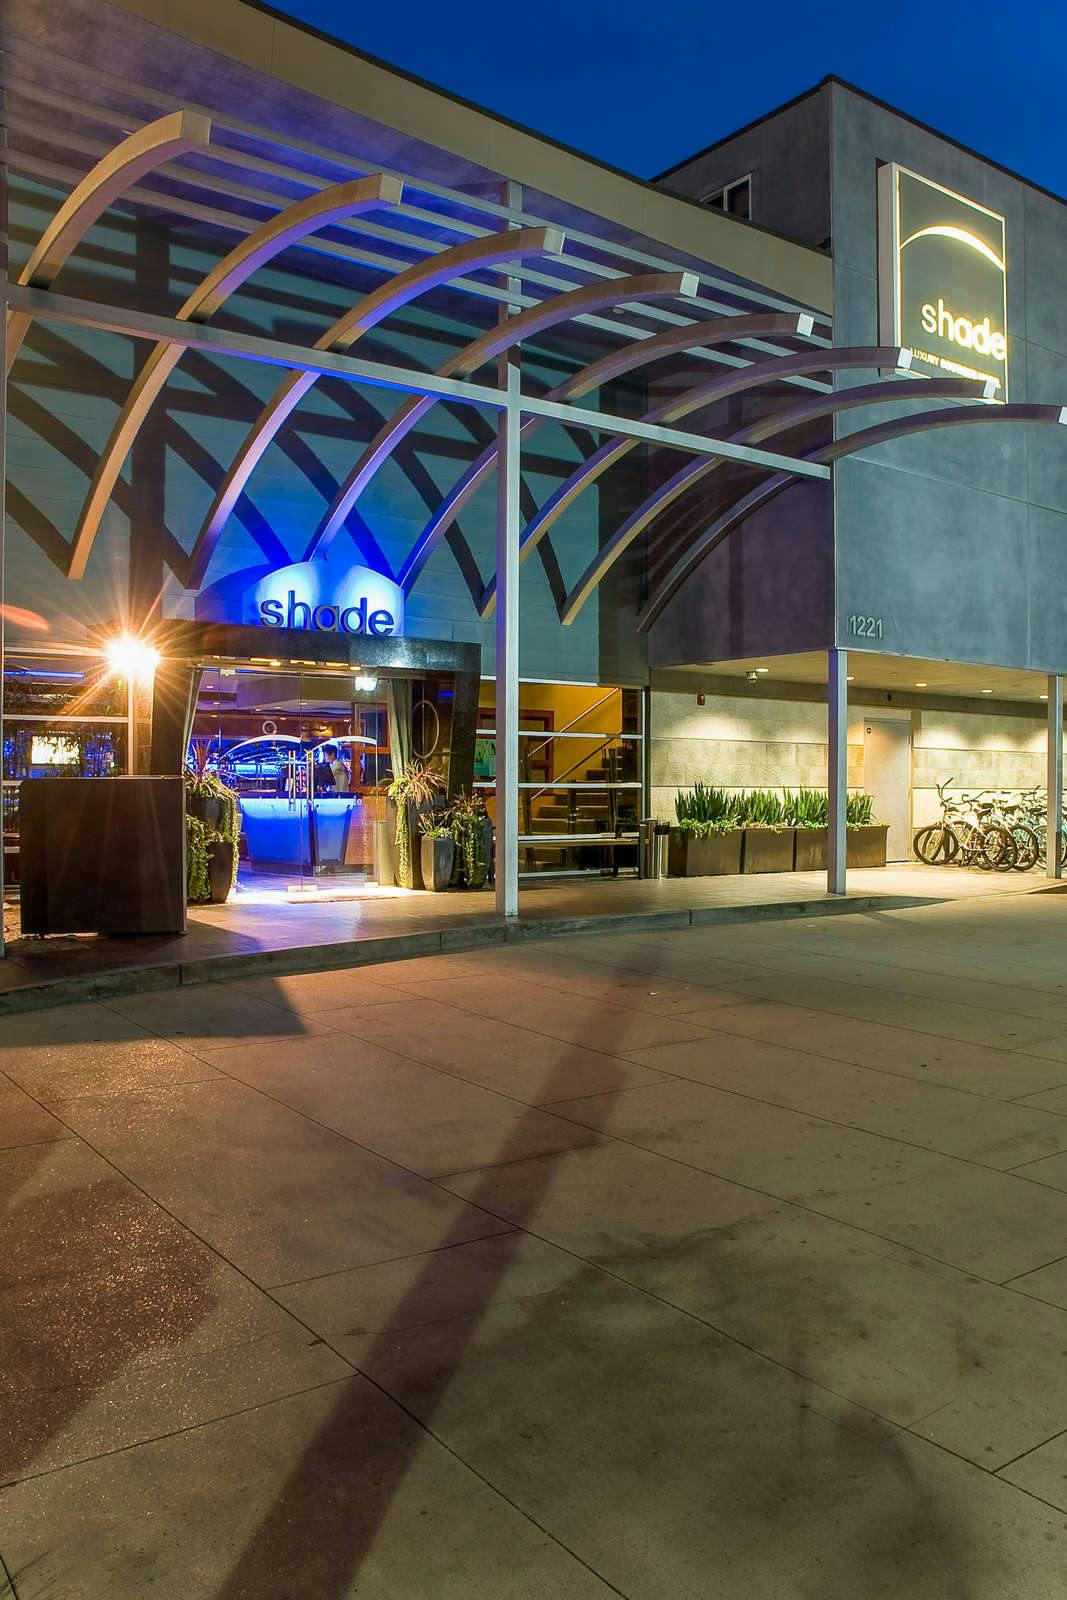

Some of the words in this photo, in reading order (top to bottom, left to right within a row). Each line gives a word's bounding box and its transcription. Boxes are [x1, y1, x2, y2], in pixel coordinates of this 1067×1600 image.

[921, 298, 1006, 361] shade
[260, 590, 395, 637] shade
[850, 615, 882, 638] 1221
